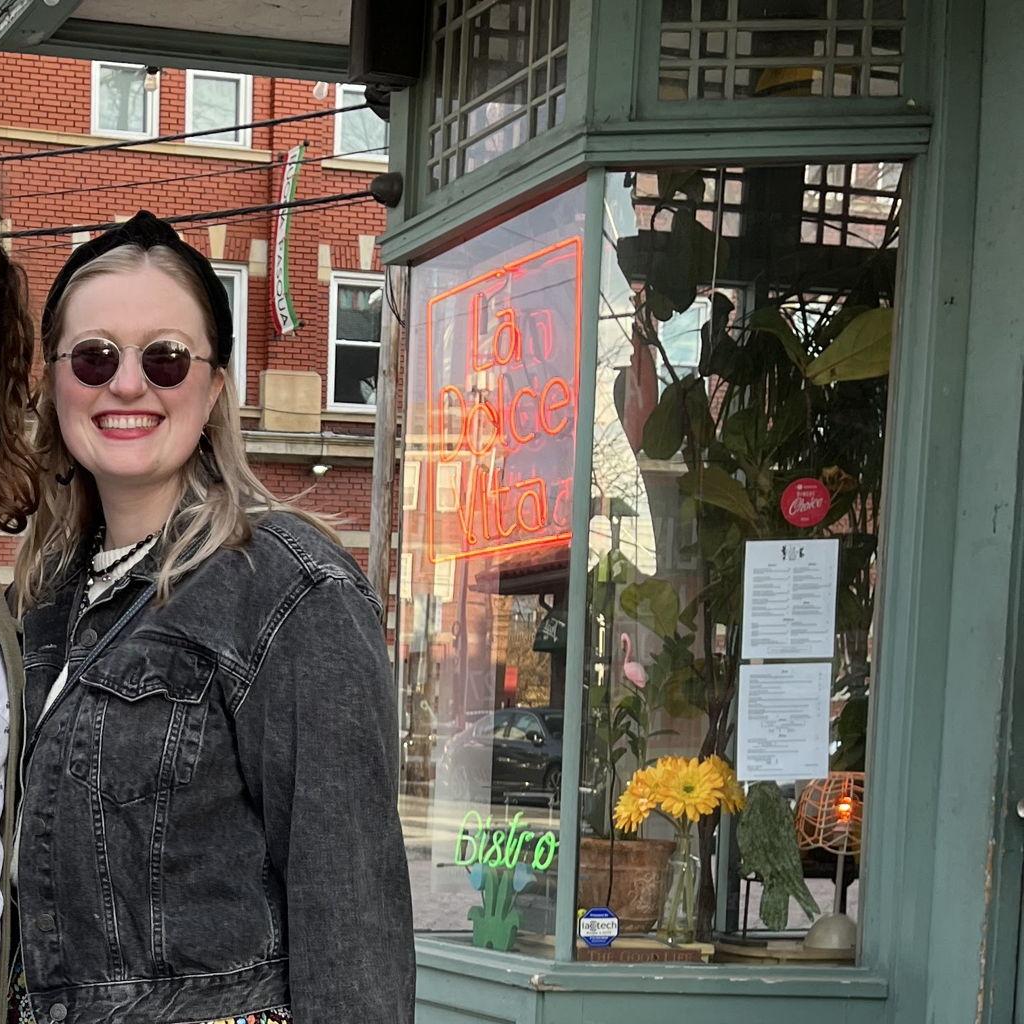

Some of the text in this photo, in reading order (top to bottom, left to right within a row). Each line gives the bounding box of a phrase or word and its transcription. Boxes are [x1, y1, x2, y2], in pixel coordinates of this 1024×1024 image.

[472, 292, 522, 372] La
[439, 374, 571, 462] Dolce
[788, 497, 824, 516] Choice
[455, 810, 560, 870] Bistro
